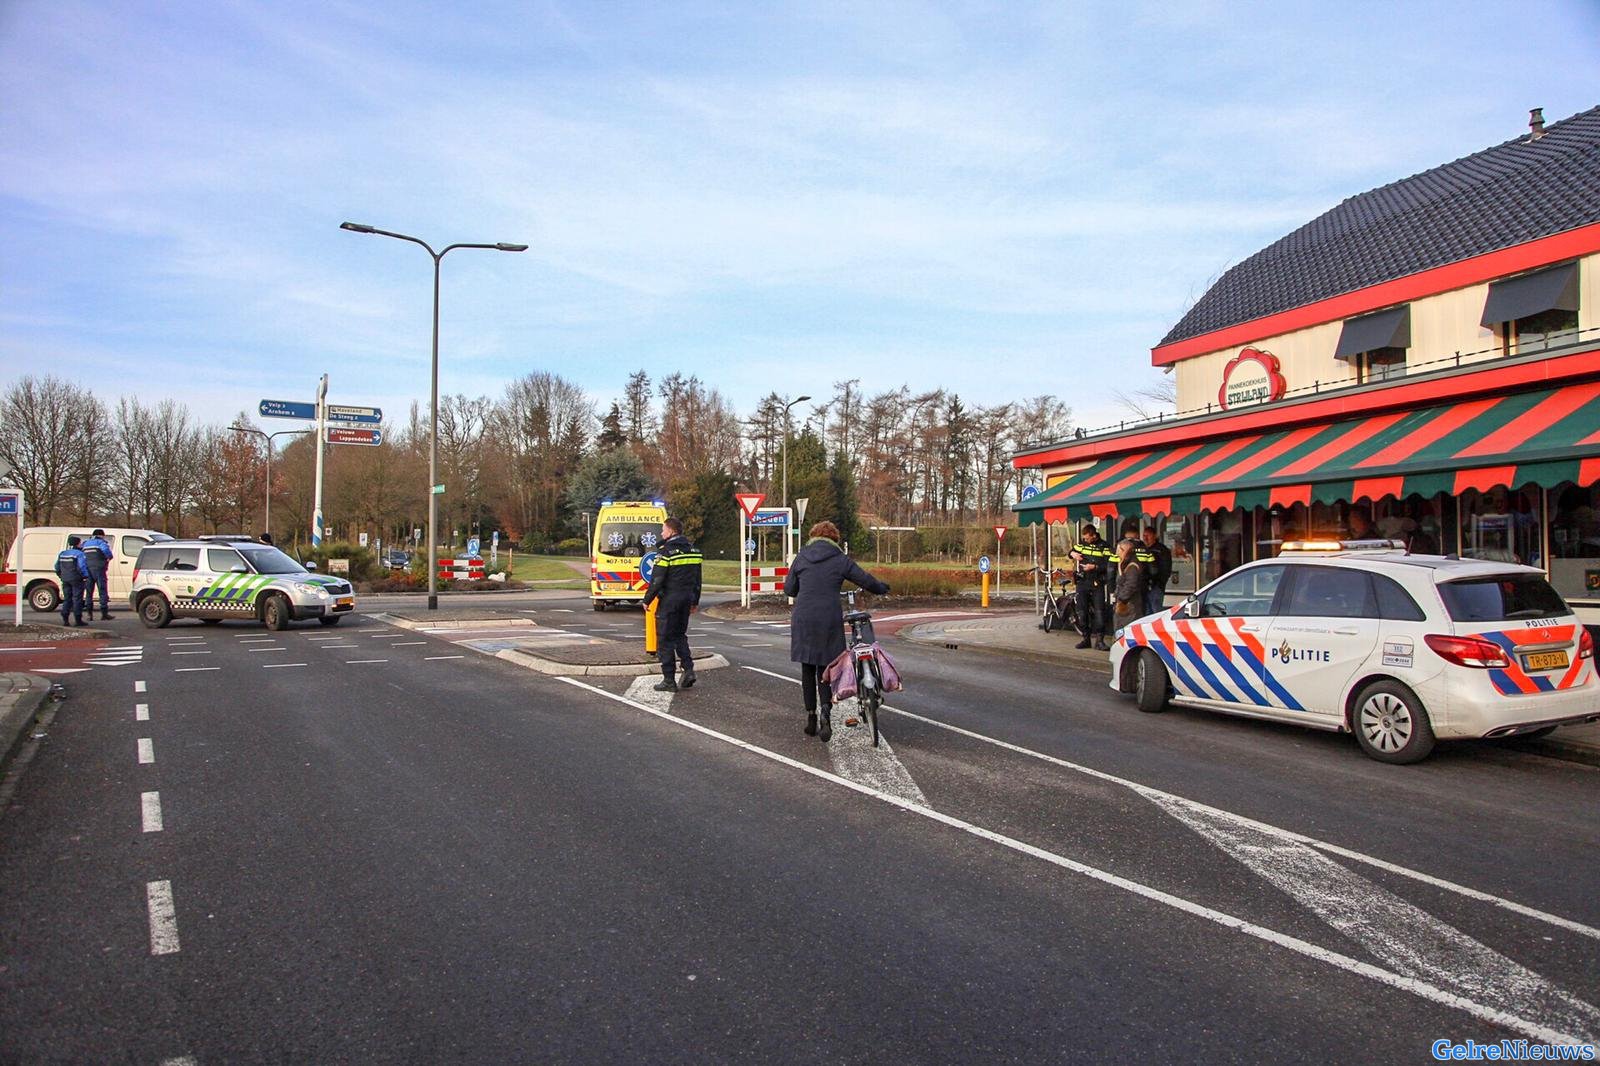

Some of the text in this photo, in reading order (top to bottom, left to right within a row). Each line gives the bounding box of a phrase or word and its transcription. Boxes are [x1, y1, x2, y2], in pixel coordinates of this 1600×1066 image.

[1228, 386, 1269, 405] STRIJLAND
[1525, 618, 1559, 628] POLITIE
[1272, 648, 1330, 664] POLITIE
[1530, 653, 1564, 667] TR-873-V
